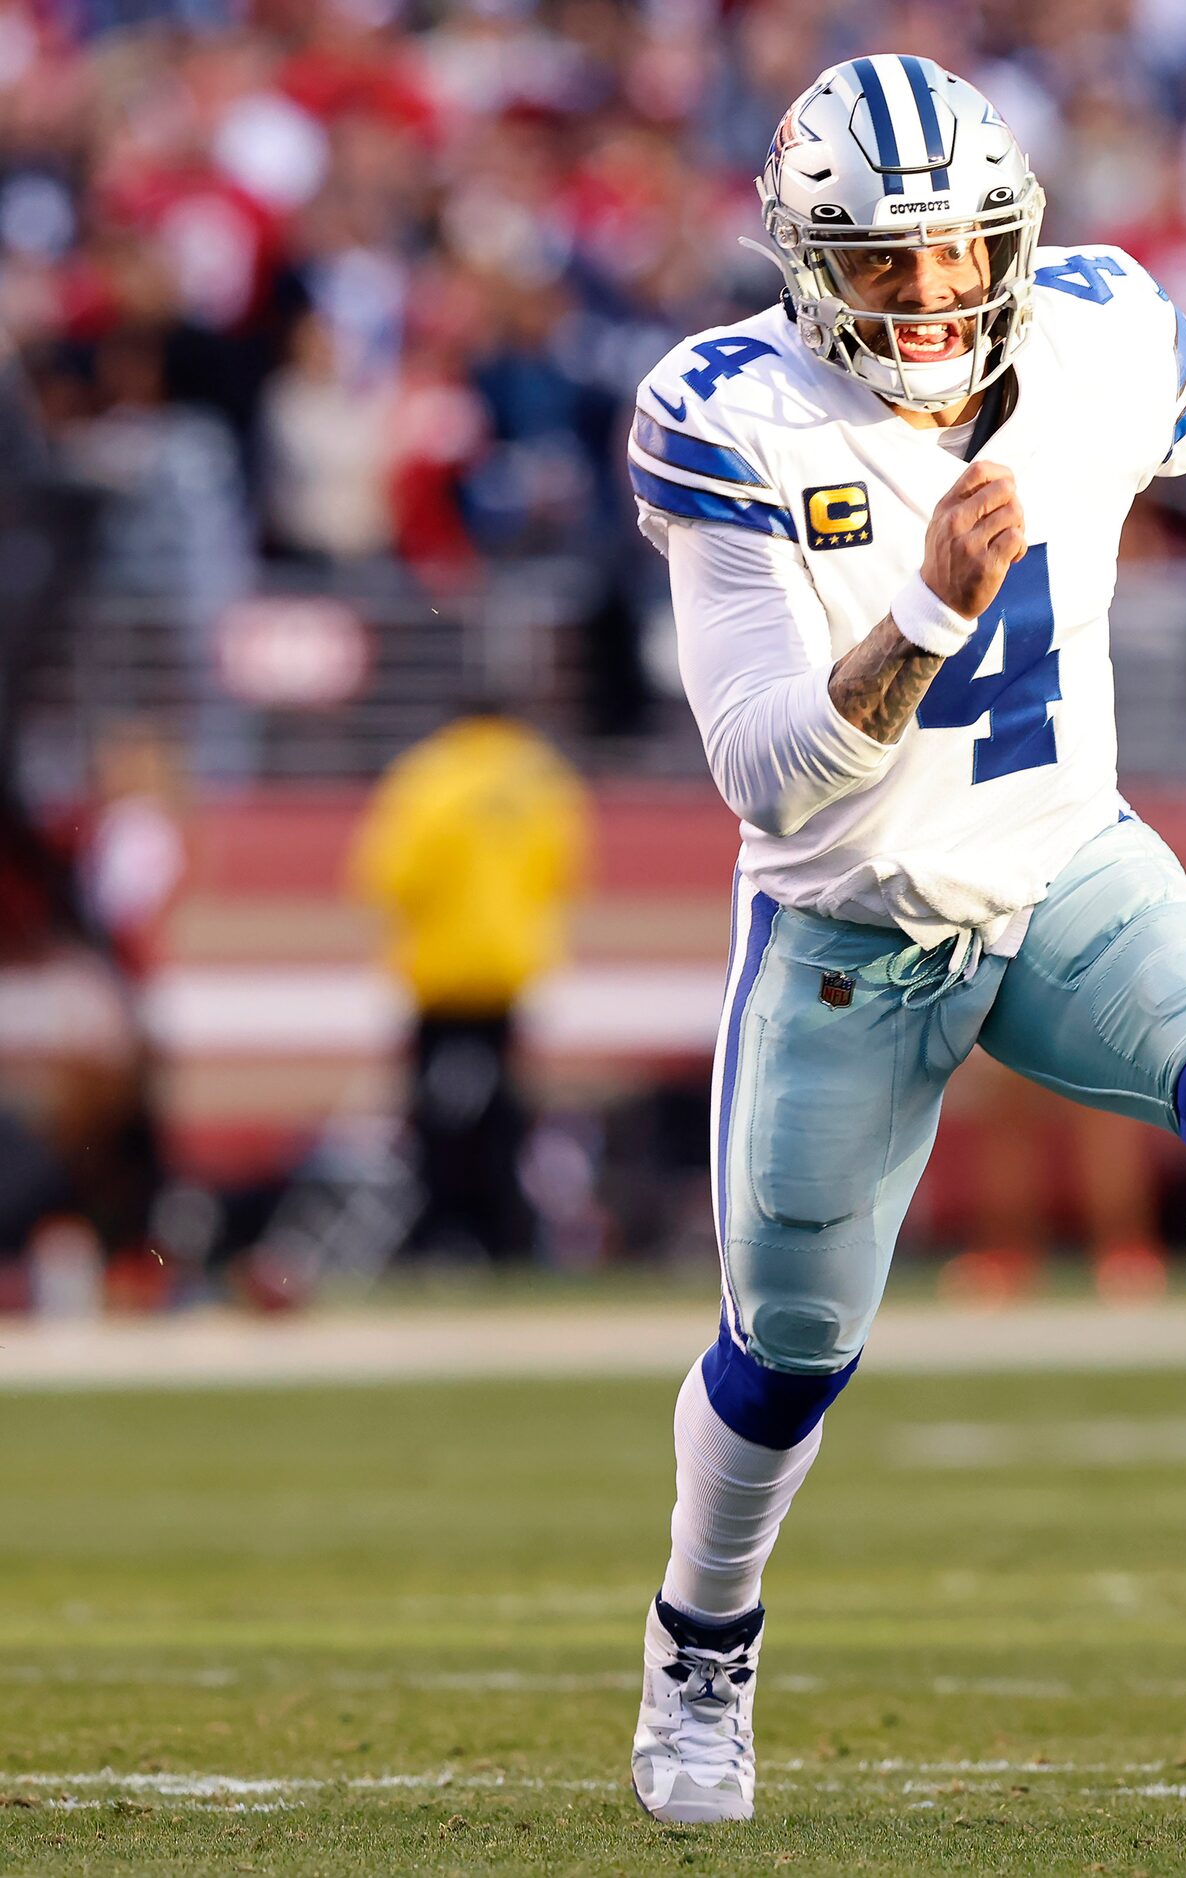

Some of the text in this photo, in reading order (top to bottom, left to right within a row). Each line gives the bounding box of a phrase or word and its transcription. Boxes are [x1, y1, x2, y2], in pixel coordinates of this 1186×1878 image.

[890, 199, 950, 214] COWBOYS
[1033, 254, 1128, 306] 4
[680, 336, 782, 402] 4
[808, 486, 869, 535] C
[915, 541, 1063, 786] 4
[823, 985, 848, 1005] NFL
